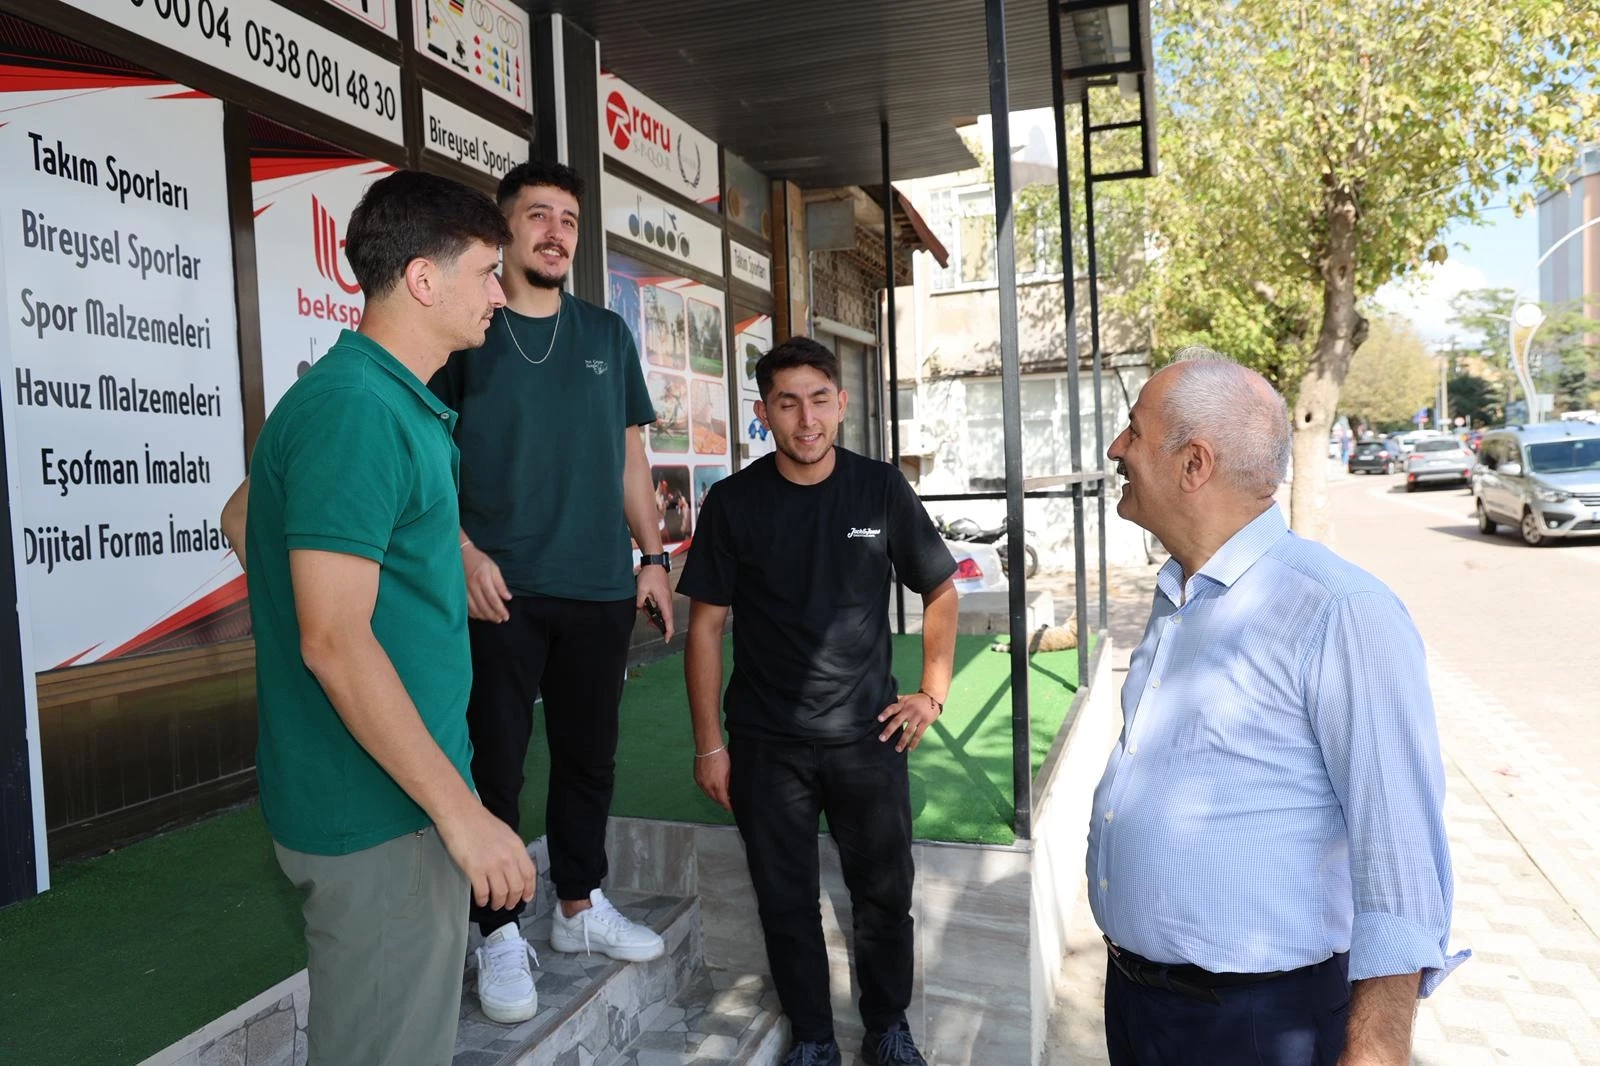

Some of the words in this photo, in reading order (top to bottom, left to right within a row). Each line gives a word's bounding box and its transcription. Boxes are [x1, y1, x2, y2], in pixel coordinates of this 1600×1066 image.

[197, 0, 231, 48] 04
[245, 20, 300, 79] 0538
[306, 49, 339, 97] 081
[346, 70, 370, 109] 48
[374, 81, 396, 121] 30
[28, 131, 98, 187] Takım
[106, 155, 189, 211] Sporları
[429, 115, 480, 161] Bireysel
[482, 141, 521, 175] Sporl
[22, 208, 121, 269] Bireysel
[128, 233, 201, 280] Sporlar
[21, 288, 78, 339] Spor
[86, 298, 211, 349] Malzemeleri
[298, 287, 361, 331] beksp
[16, 367, 92, 409] Havuz
[99, 374, 221, 417] Malzemeleri
[41, 448, 139, 496] Eşofman
[145, 442, 210, 484] İmalatı
[24, 524, 92, 575] Dijital
[99, 524, 164, 559] Forma
